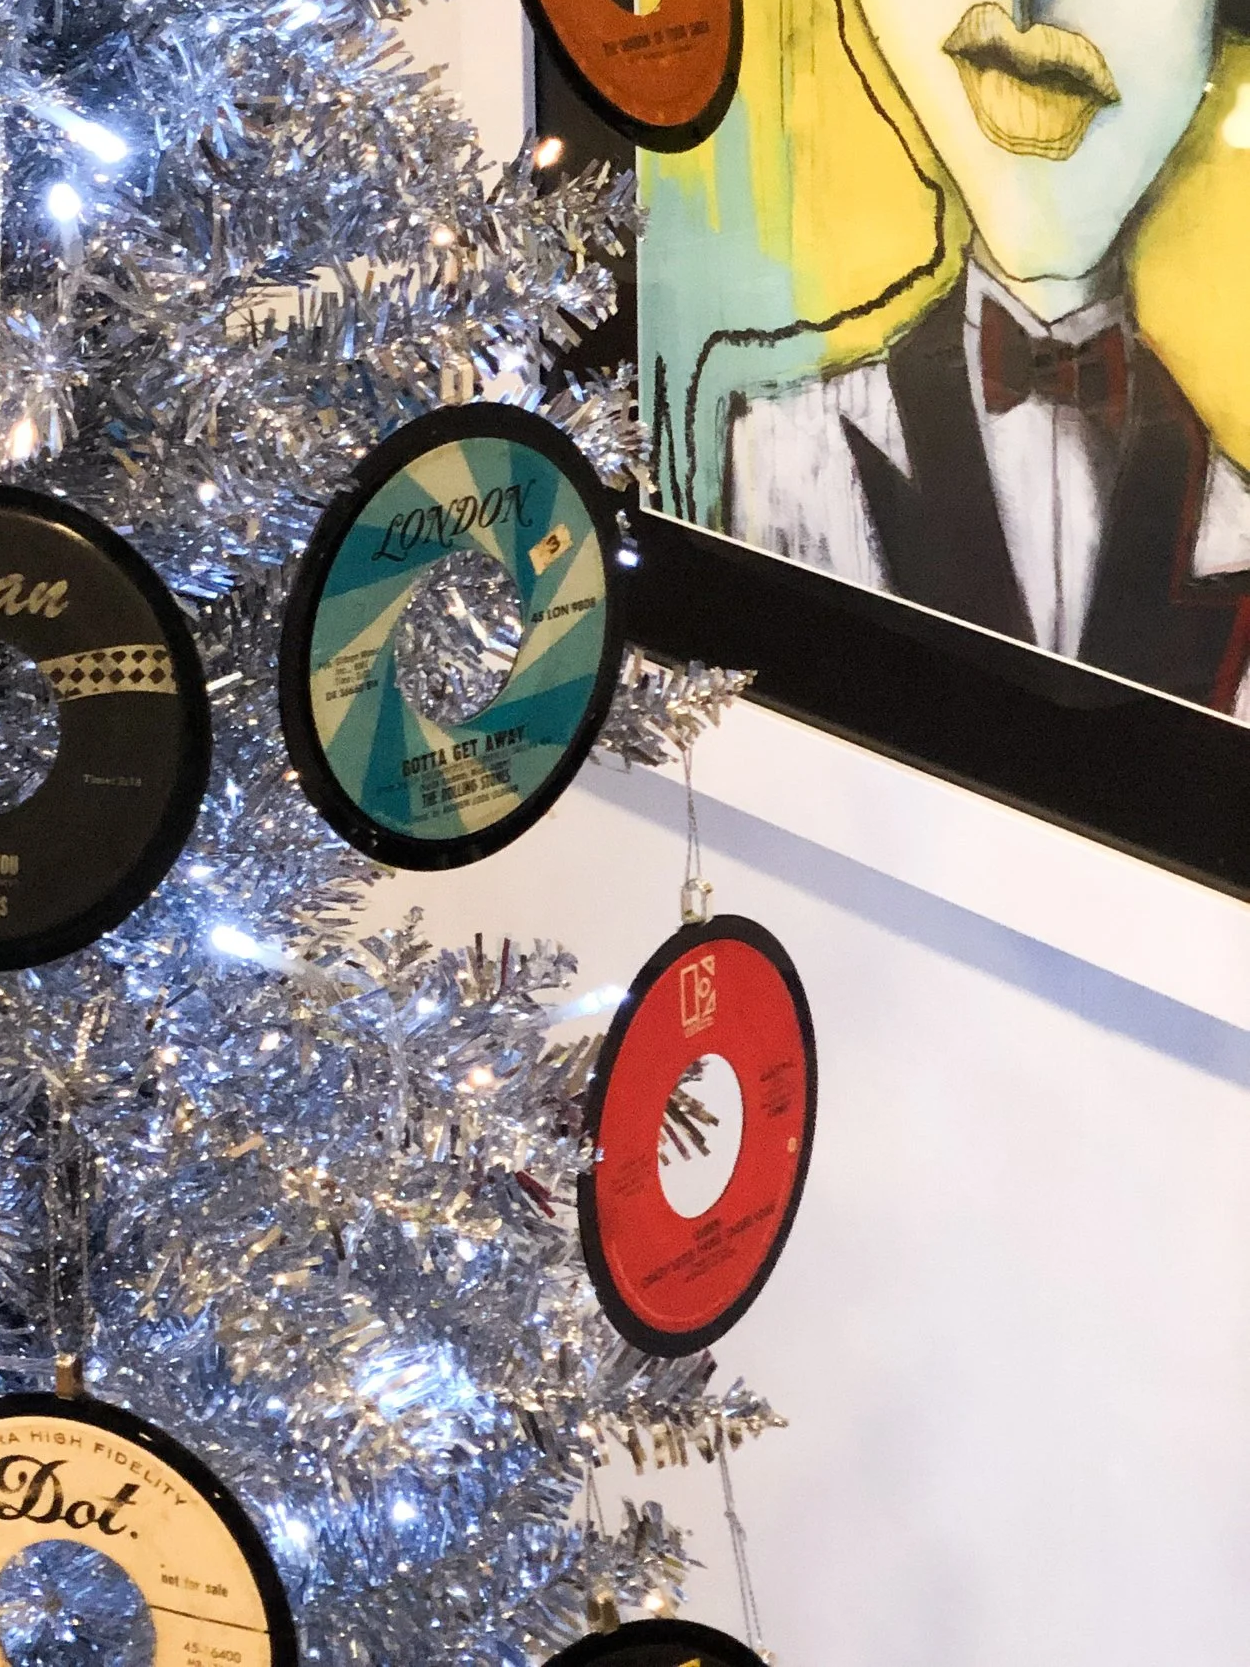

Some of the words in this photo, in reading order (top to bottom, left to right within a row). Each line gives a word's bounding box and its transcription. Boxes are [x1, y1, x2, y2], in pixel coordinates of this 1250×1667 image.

[371, 478, 537, 562] LONDON
[546, 534, 561, 554] 3
[531, 610, 544, 623] 45
[547, 604, 569, 620] LON
[402, 748, 447, 777] GOTTA
[452, 739, 478, 761] GET
[485, 726, 526, 752] AWAY
[30, 1430, 82, 1448] HIGH
[94, 1441, 188, 1506] FIDELITY
[161, 1574, 179, 1587] not
[205, 1584, 228, 1598] sale
